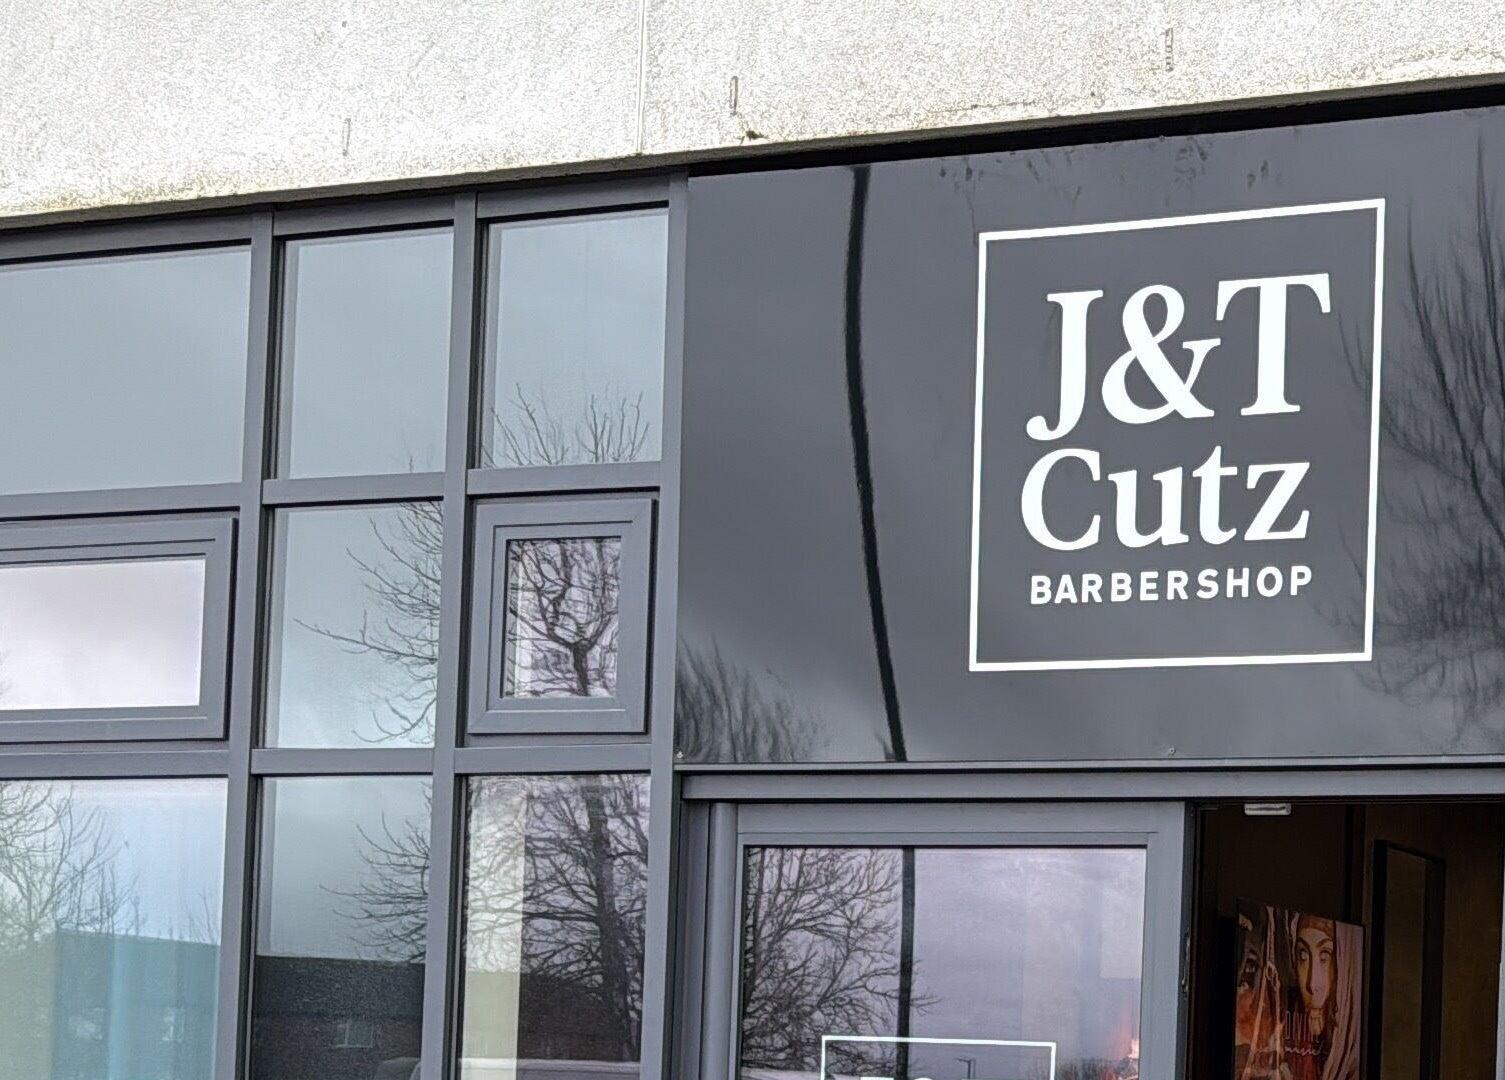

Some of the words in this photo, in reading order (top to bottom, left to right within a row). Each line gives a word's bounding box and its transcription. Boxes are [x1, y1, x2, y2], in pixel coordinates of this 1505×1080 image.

[1026, 273, 1331, 441] J&T
[1021, 446, 1310, 551] Cutz
[1030, 565, 1312, 605] BARBERSHOP
